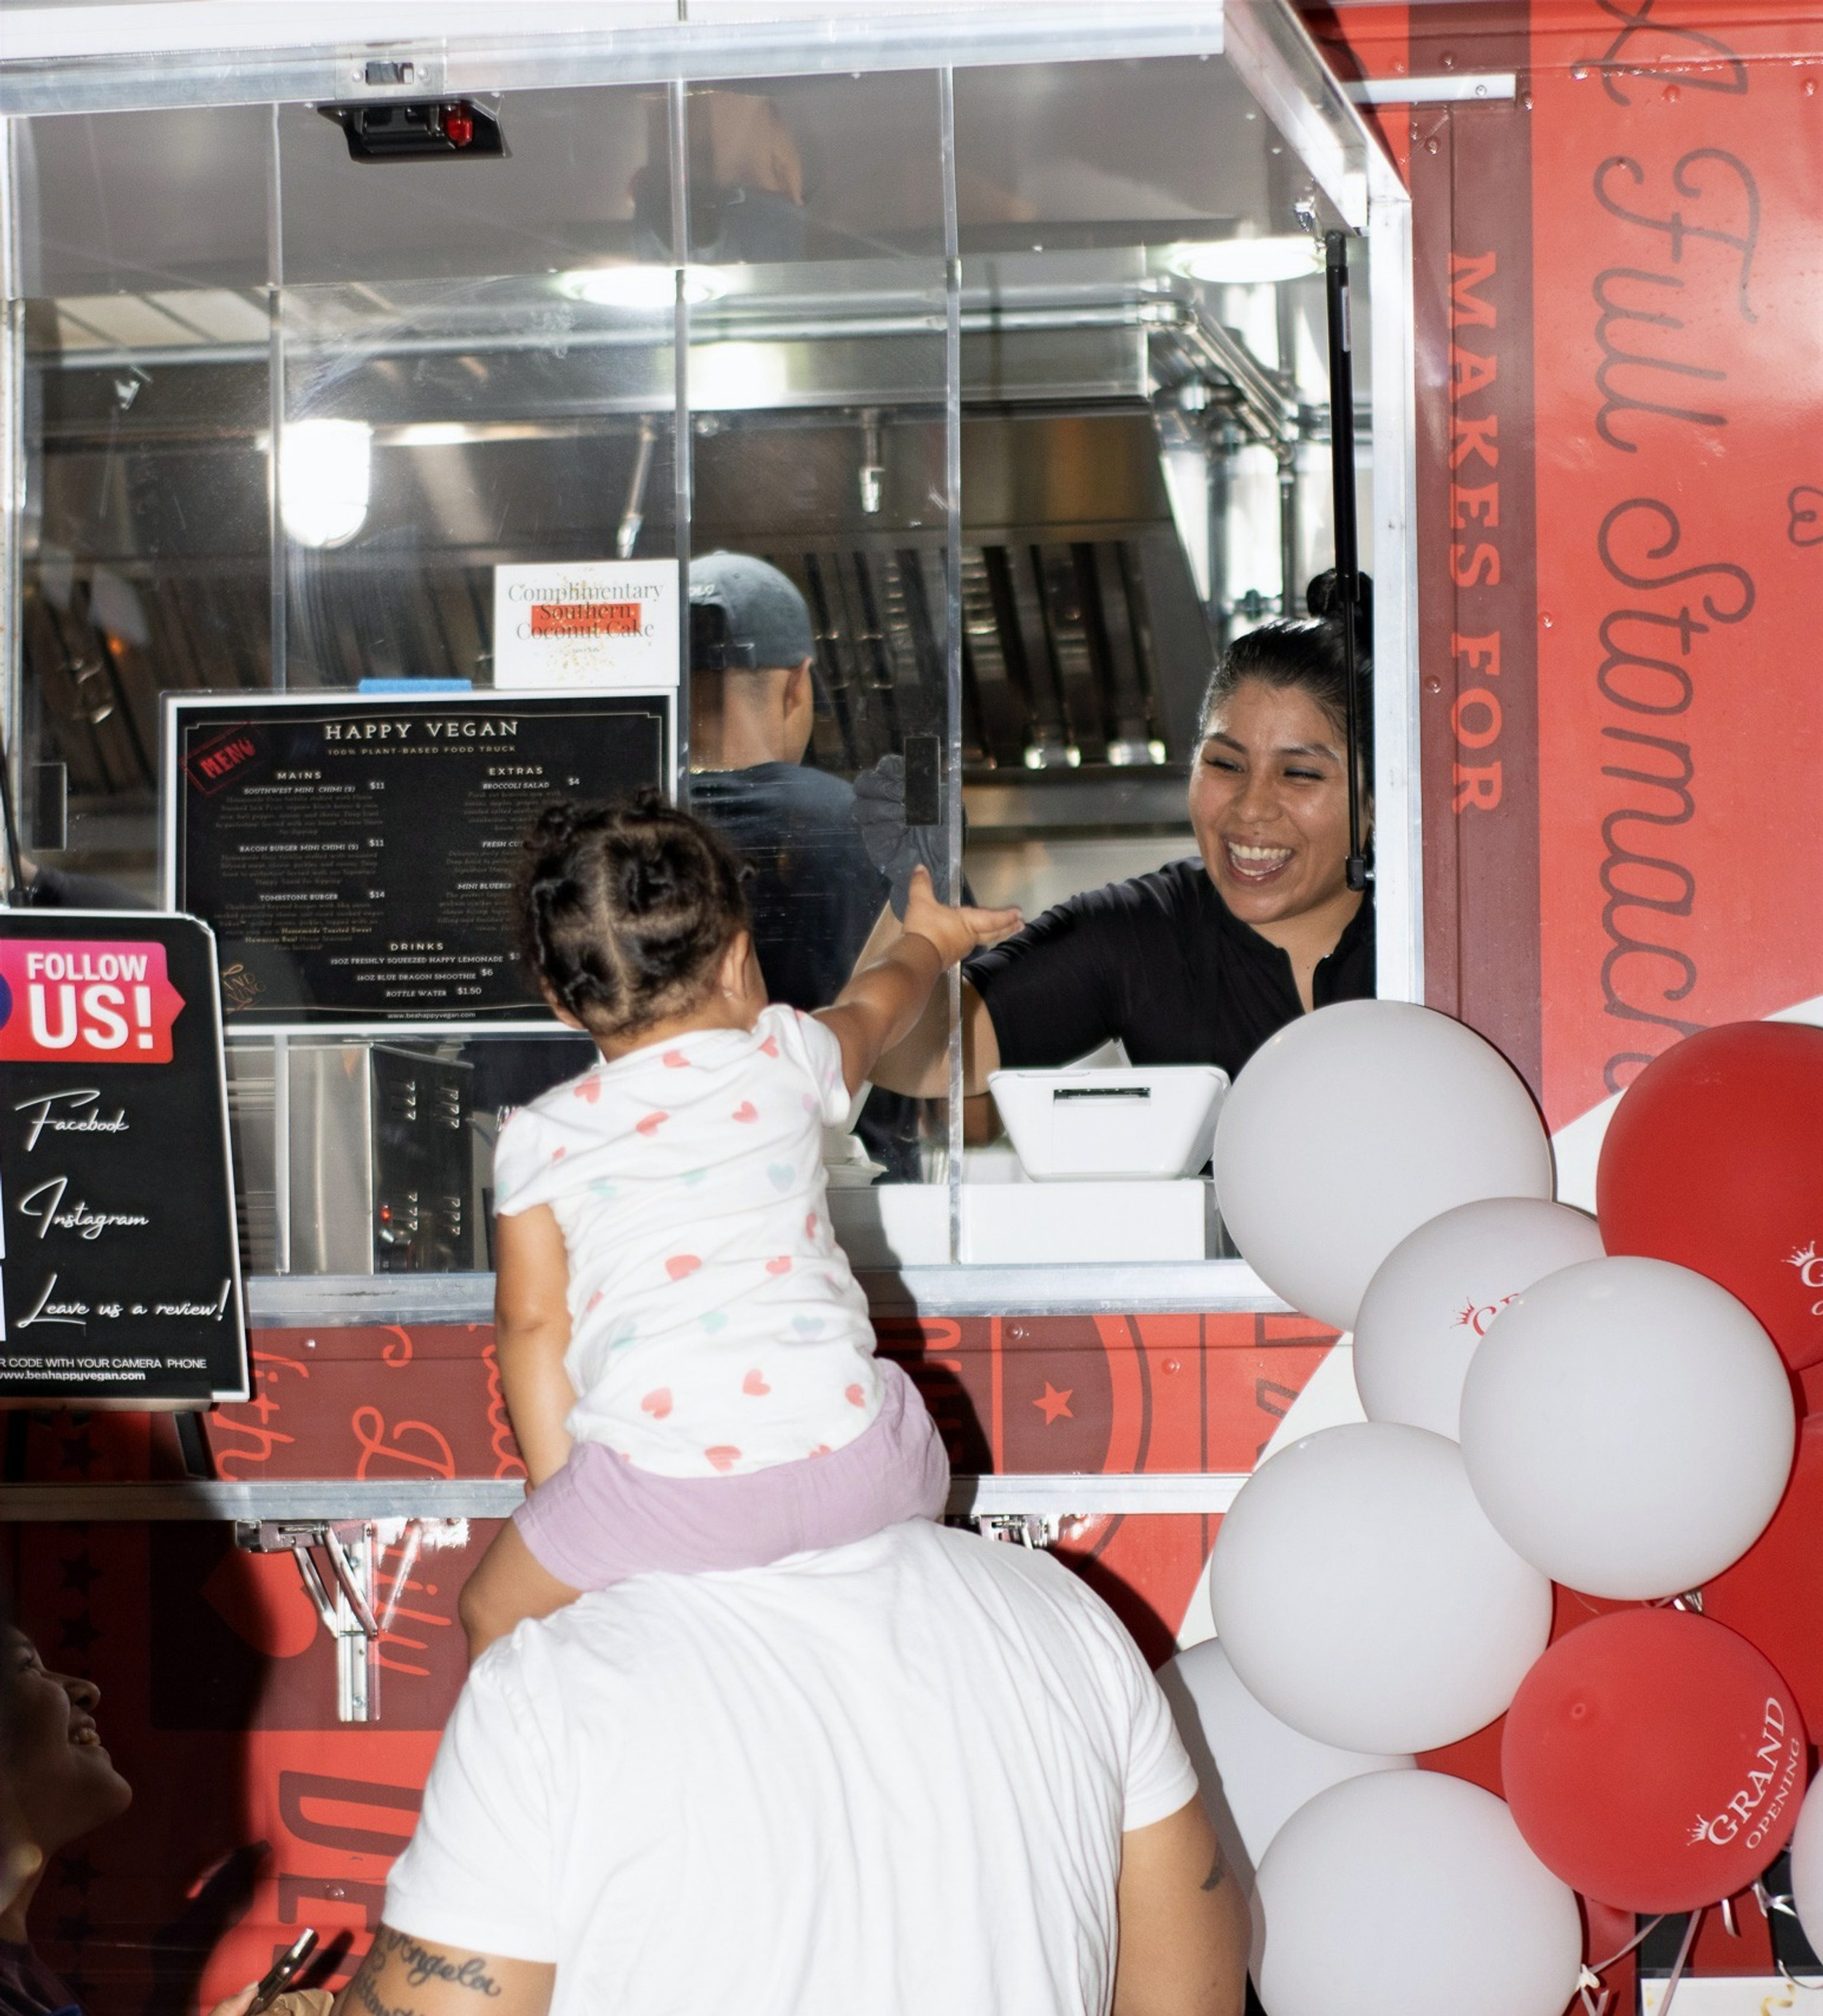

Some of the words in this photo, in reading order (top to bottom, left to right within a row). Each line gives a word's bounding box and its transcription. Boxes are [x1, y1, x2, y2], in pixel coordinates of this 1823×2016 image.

[1593, 147, 1761, 453] Full
[1447, 251, 1501, 589] MAKES
[508, 582, 664, 604] Complimentary
[540, 602, 631, 620] Southern
[516, 621, 600, 640] Coconut
[607, 620, 655, 639] Cake
[1450, 631, 1504, 815] FOR
[324, 724, 413, 740] HAPPY
[427, 721, 518, 738] VEGAN
[361, 747, 439, 756] PLANT-BASED
[480, 745, 516, 753] TRUCK
[199, 737, 256, 780] MENU
[277, 771, 322, 780] MAINS
[489, 767, 544, 776] EXTRAS
[370, 781, 386, 791] $11
[482, 782, 522, 790] BROCCOLI
[523, 781, 550, 789] SALAD
[568, 778, 580, 786] $4
[244, 786, 292, 795] SOUTHWEST
[294, 786, 315, 794] MINI
[239, 845, 268, 853] BACON
[269, 844, 299, 853] BURGER
[300, 843, 320, 852] MINI
[321, 843, 347, 852] CHIMI
[369, 839, 385, 848] $11
[457, 883, 478, 891] MINI
[260, 894, 308, 902] TOMBSTONE
[309, 893, 339, 902] BURGER
[369, 891, 386, 900] $14
[391, 942, 444, 951] DRINKS
[350, 957, 385, 965] FRESHLY
[429, 956, 456, 964] HAPPY
[458, 955, 503, 964] LEMONADE
[26, 952, 148, 982] FOLLOW
[434, 973, 476, 981] SMOOTHIE
[481, 968, 494, 977] $6
[386, 990, 416, 998] BOTTLE
[418, 990, 447, 998] WATER
[456, 987, 482, 996] $1.50
[29, 983, 154, 1050] US!
[387, 1011, 476, 1020] www.beahappyvegan.com
[15, 1090, 130, 1152] Facebook
[20, 1177, 149, 1239] Instagram
[18, 1273, 90, 1329] Leave
[98, 1303, 123, 1318] us
[133, 1303, 147, 1315] a
[155, 1279, 232, 1322] review!
[9, 1357, 44, 1369] CODE
[44, 1357, 74, 1369] WITH
[77, 1357, 110, 1369] YOUR
[112, 1357, 163, 1369] CAMERA
[167, 1357, 208, 1369] PHONE
[1706, 1697, 1786, 1846] GRAND
[1745, 1737, 1801, 1850] OPENING
